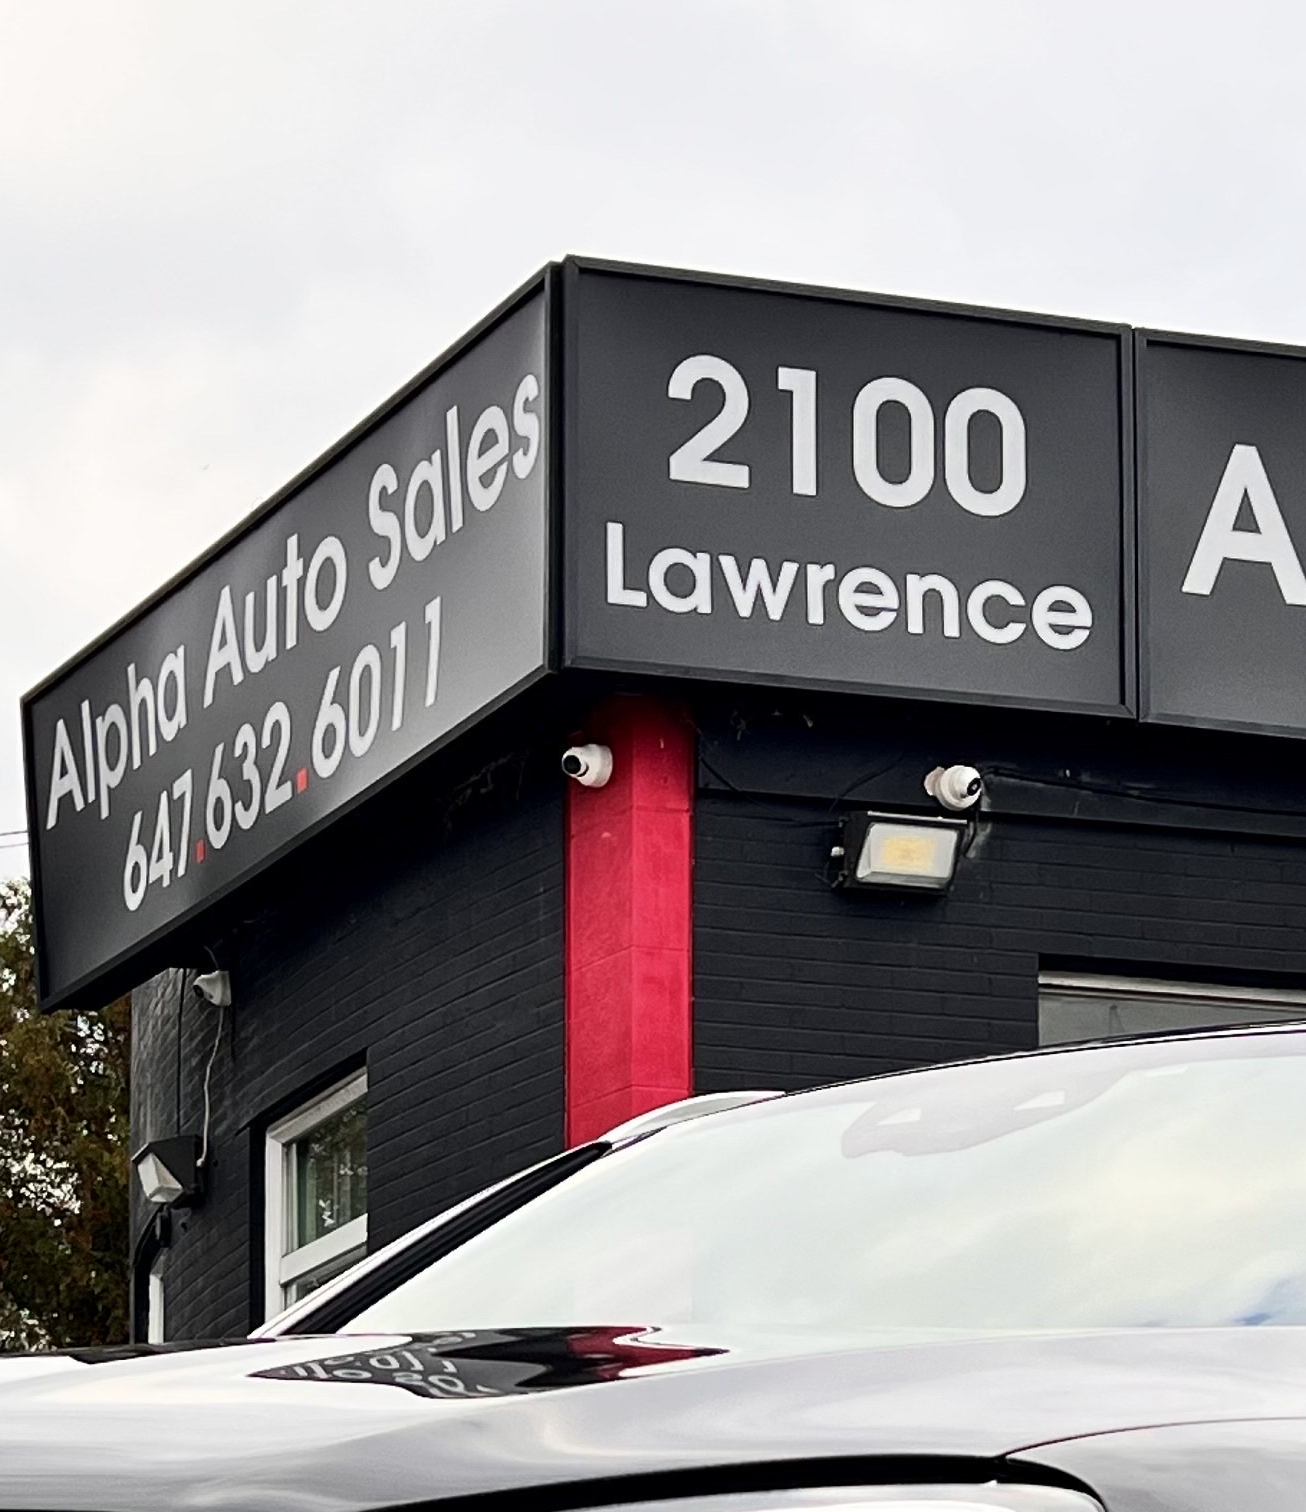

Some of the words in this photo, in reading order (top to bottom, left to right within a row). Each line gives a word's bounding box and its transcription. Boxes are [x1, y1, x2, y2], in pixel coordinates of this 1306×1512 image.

[668, 355, 1027, 517] 2100
[46, 643, 187, 830] Alpha
[203, 533, 347, 709] Auto
[368, 374, 540, 590] Sales
[605, 522, 1094, 650] Lawrence
[123, 596, 441, 911] 647.632.6011
